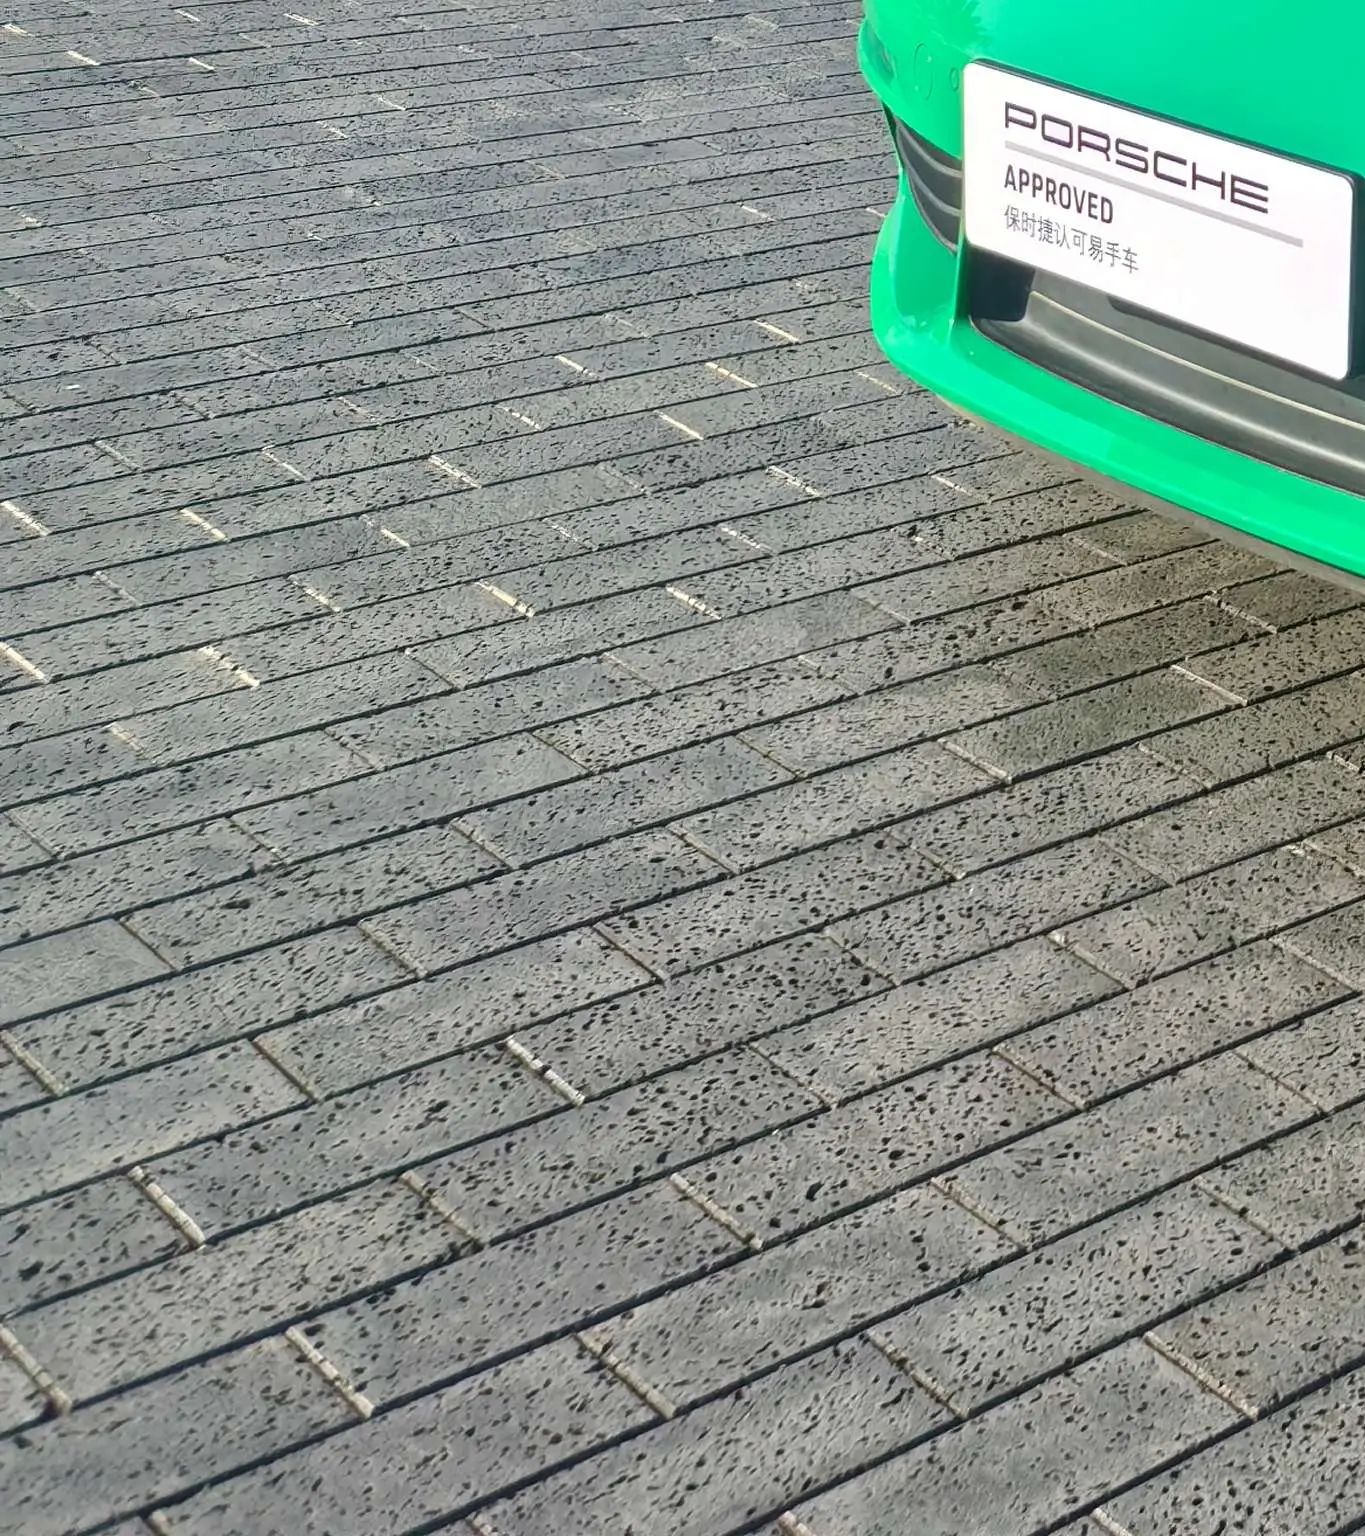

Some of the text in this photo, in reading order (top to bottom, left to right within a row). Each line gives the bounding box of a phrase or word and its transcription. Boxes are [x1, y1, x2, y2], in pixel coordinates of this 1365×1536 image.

[1004, 101, 1270, 215] PORSCHE
[1004, 163, 1114, 225] APPROVED
[1003, 203, 1140, 275] 保时捷认可易手车
